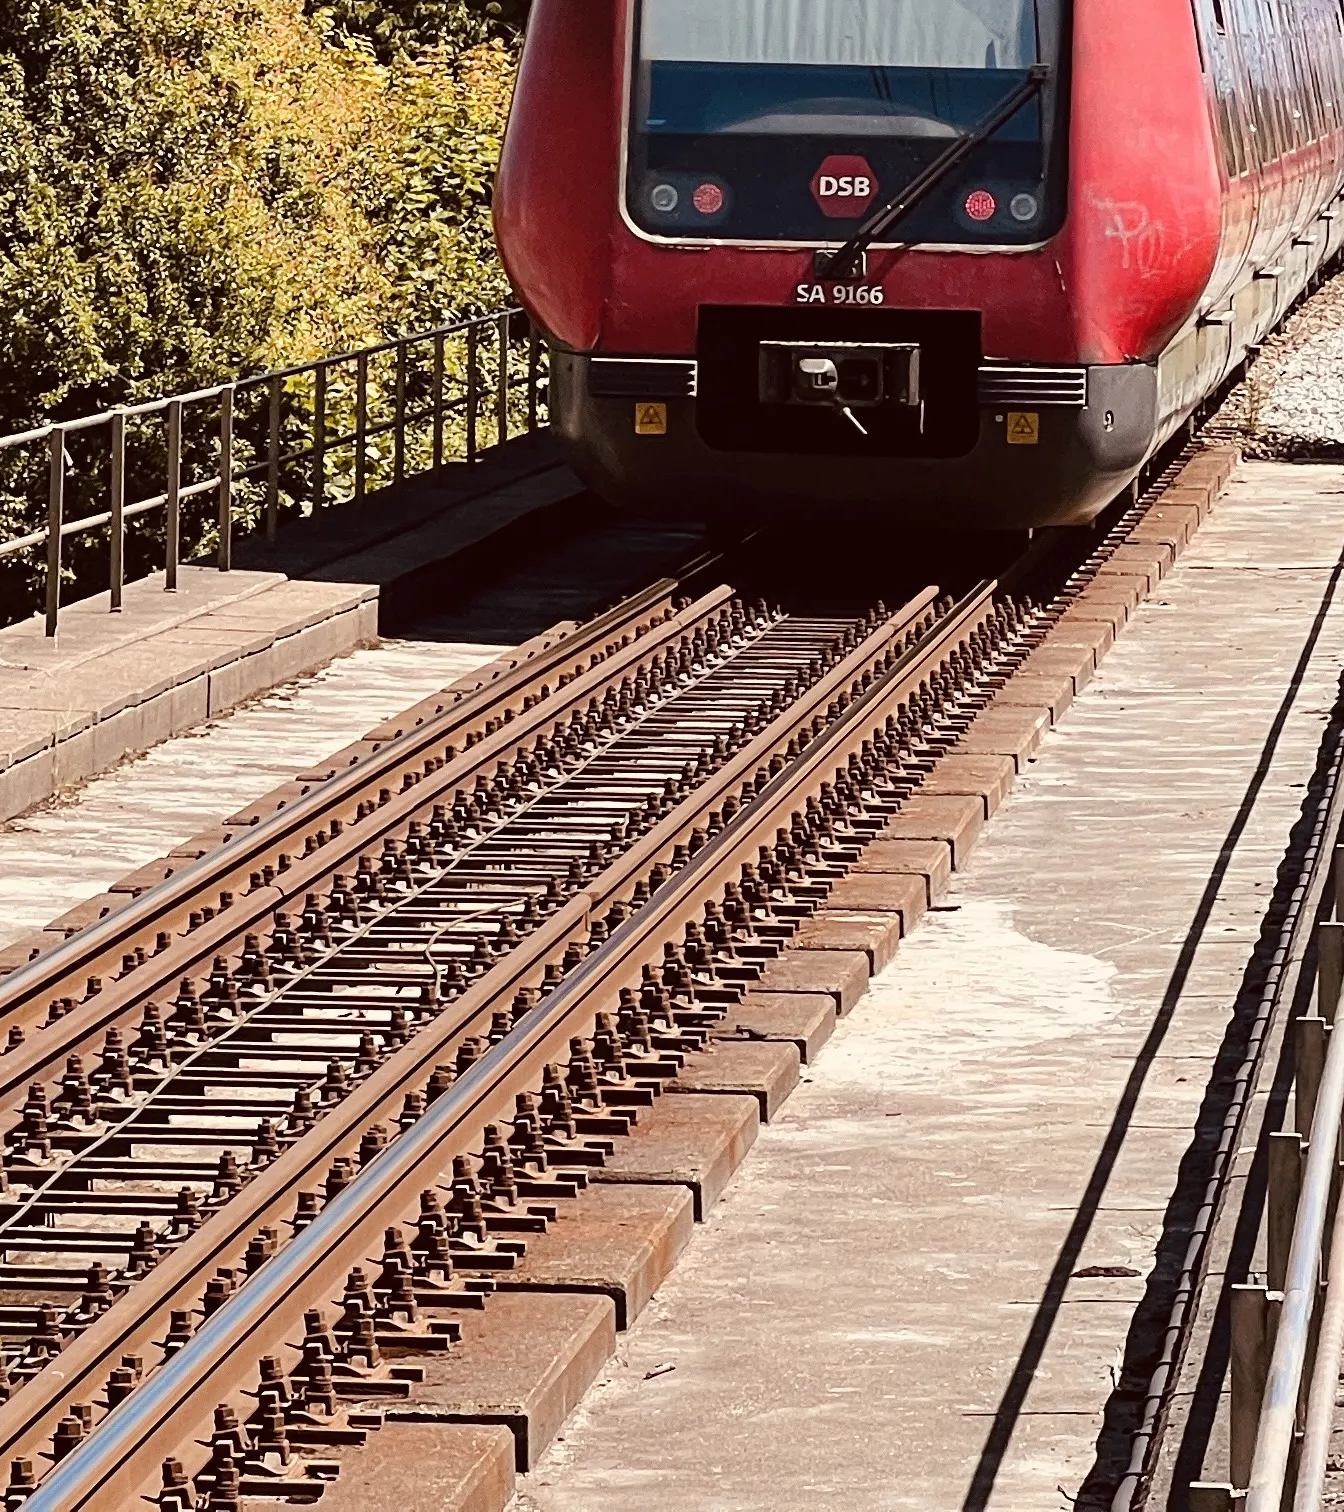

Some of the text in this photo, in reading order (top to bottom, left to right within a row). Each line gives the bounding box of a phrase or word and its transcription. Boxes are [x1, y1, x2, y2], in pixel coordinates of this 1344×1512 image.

[819, 176, 870, 197] DSB
[796, 284, 884, 305] SA 9166
